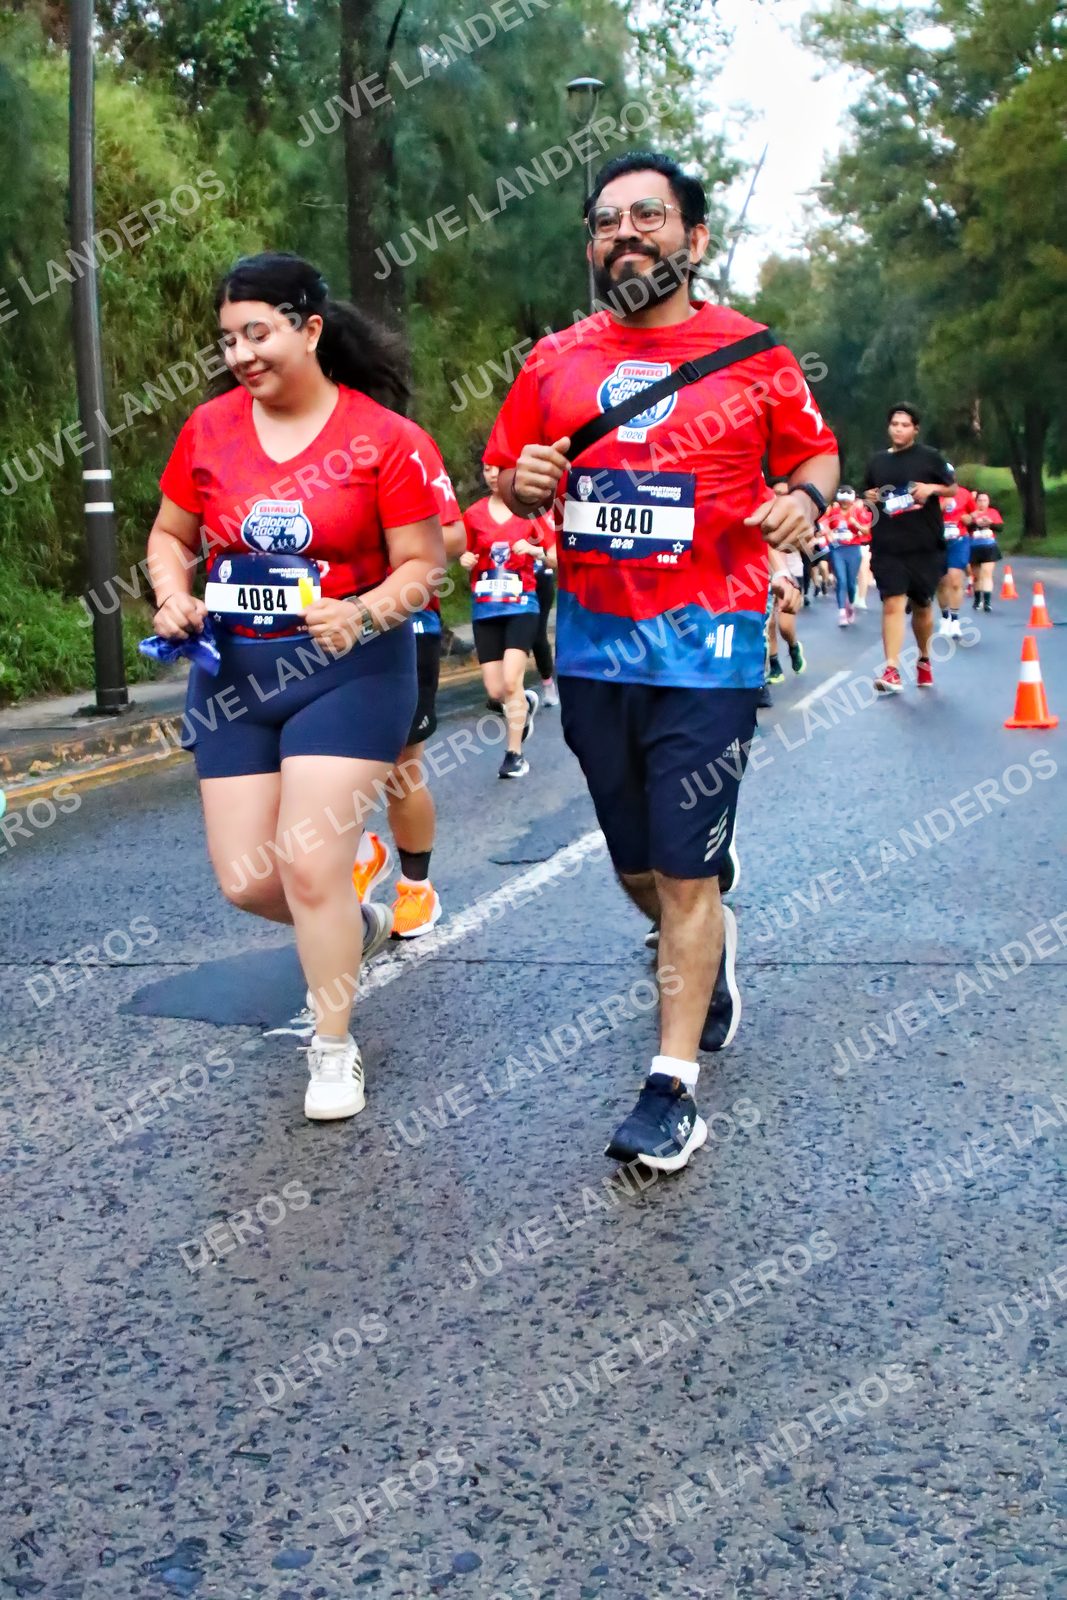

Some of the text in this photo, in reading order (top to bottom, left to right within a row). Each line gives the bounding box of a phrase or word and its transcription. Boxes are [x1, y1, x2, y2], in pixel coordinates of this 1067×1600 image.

[623, 368, 663, 377] BIMBO
[620, 431, 644, 440] 2026
[259, 516, 295, 528] Global
[596, 506, 653, 534] 4840
[252, 526, 281, 537] Race
[657, 554, 678, 564] 10K
[237, 587, 287, 612] 4084
